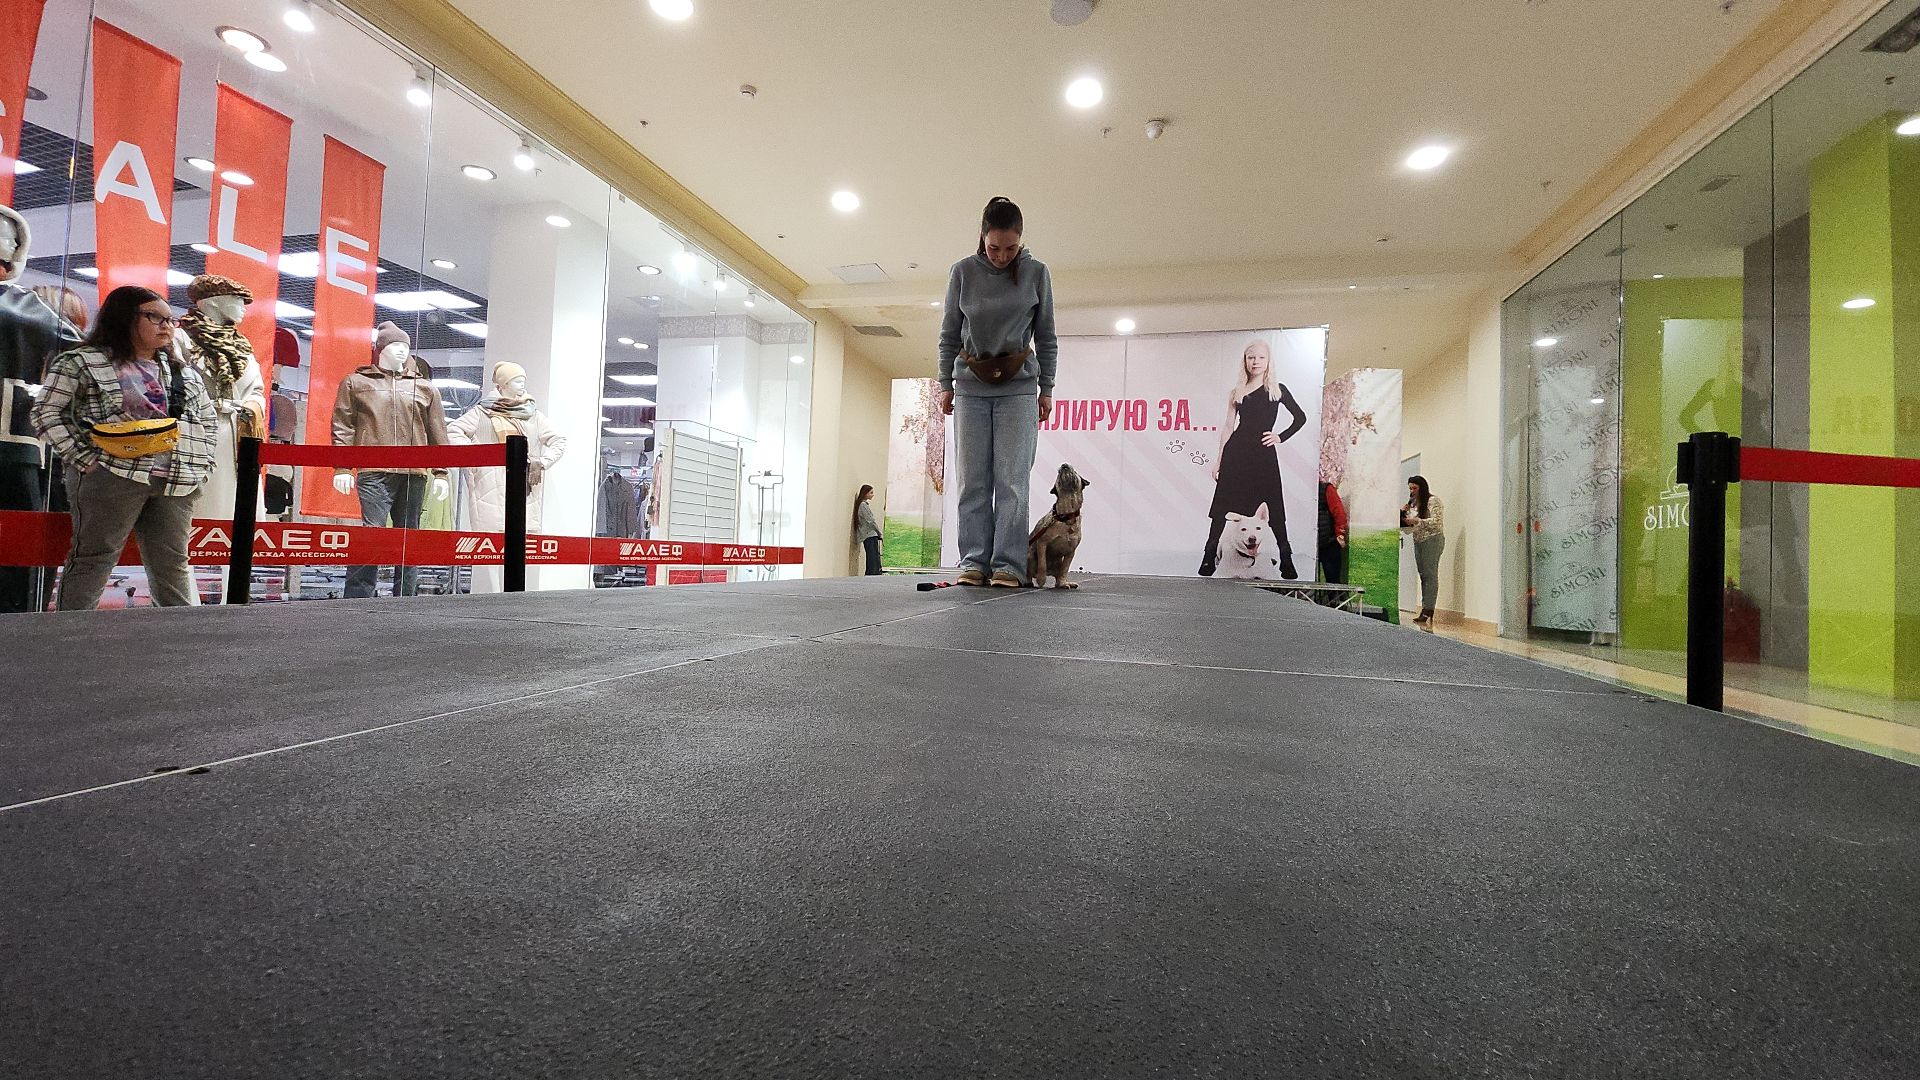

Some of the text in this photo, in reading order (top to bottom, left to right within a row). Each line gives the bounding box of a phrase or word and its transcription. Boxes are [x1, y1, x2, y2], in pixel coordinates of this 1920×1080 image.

[1157, 399, 1217, 432] ЗА...
[1561, 516, 1618, 549] SIMONI
[477, 537, 558, 554] АЕФ
[632, 544, 682, 556] АЛЕФ
[731, 547, 766, 558] АЛЕФ
[1551, 567, 1606, 599] SIMONI
